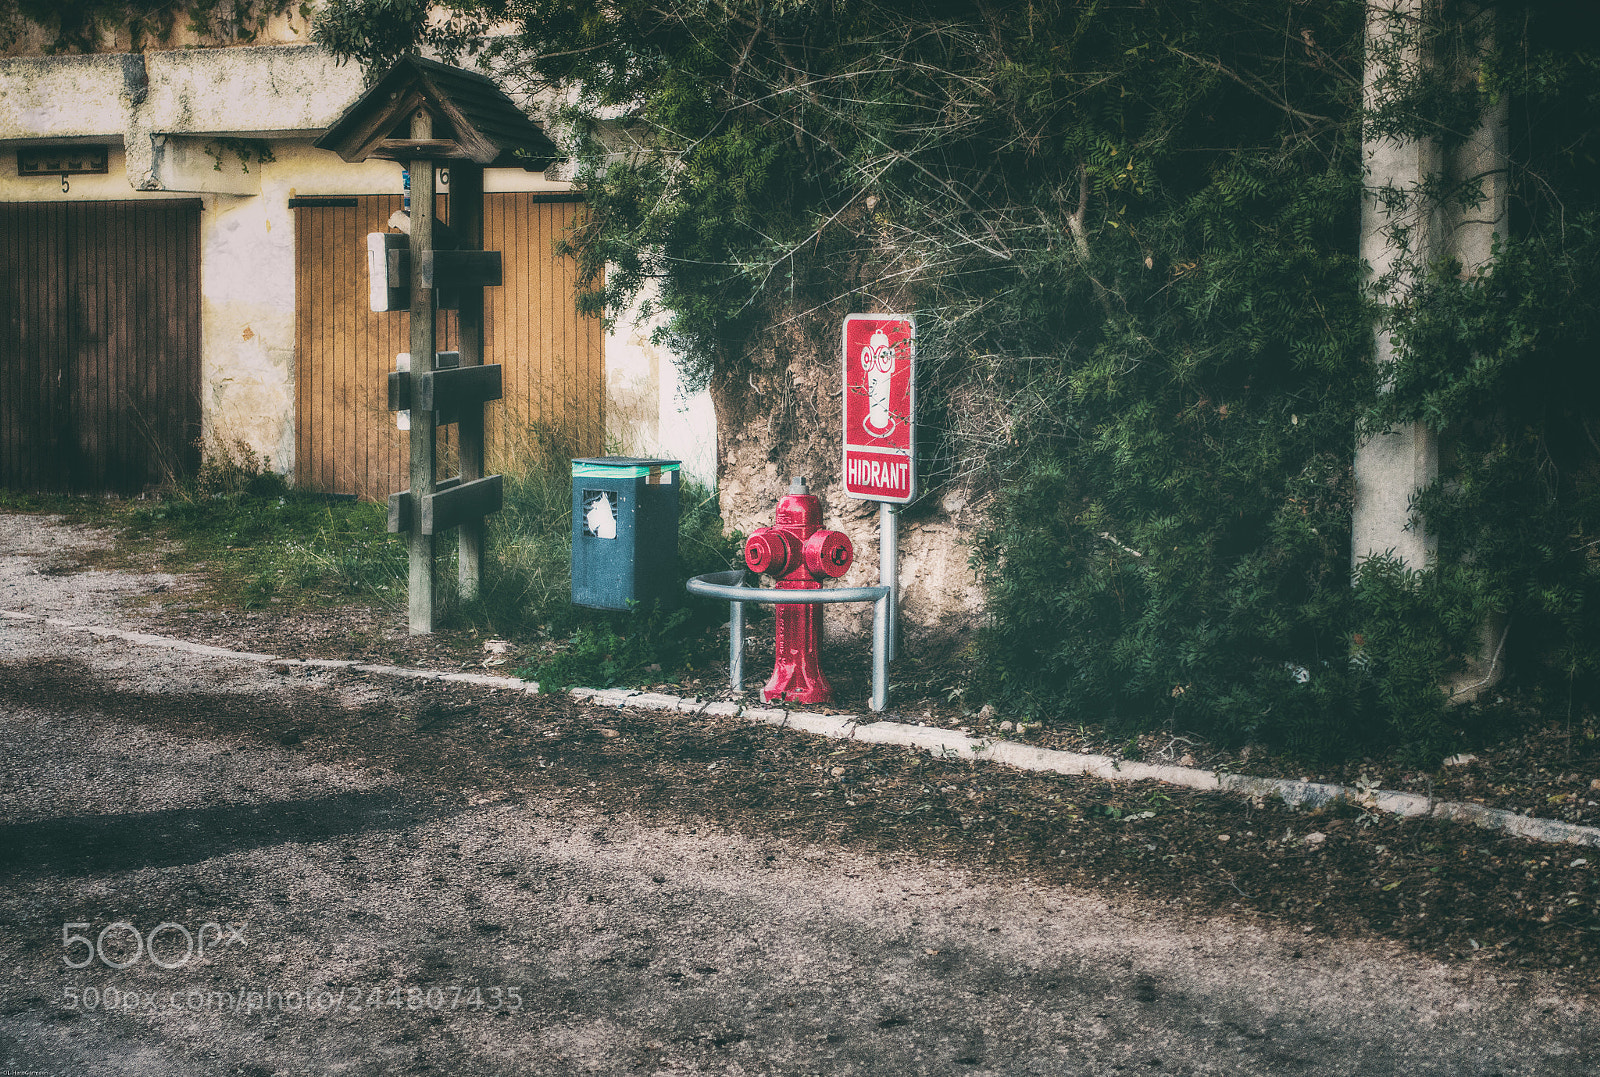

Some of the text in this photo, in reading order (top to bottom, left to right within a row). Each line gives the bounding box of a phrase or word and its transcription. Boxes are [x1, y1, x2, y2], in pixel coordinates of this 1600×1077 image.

[61, 174, 70, 193] 5
[440, 168, 450, 185] 6
[848, 458, 908, 490] HIDRANT
